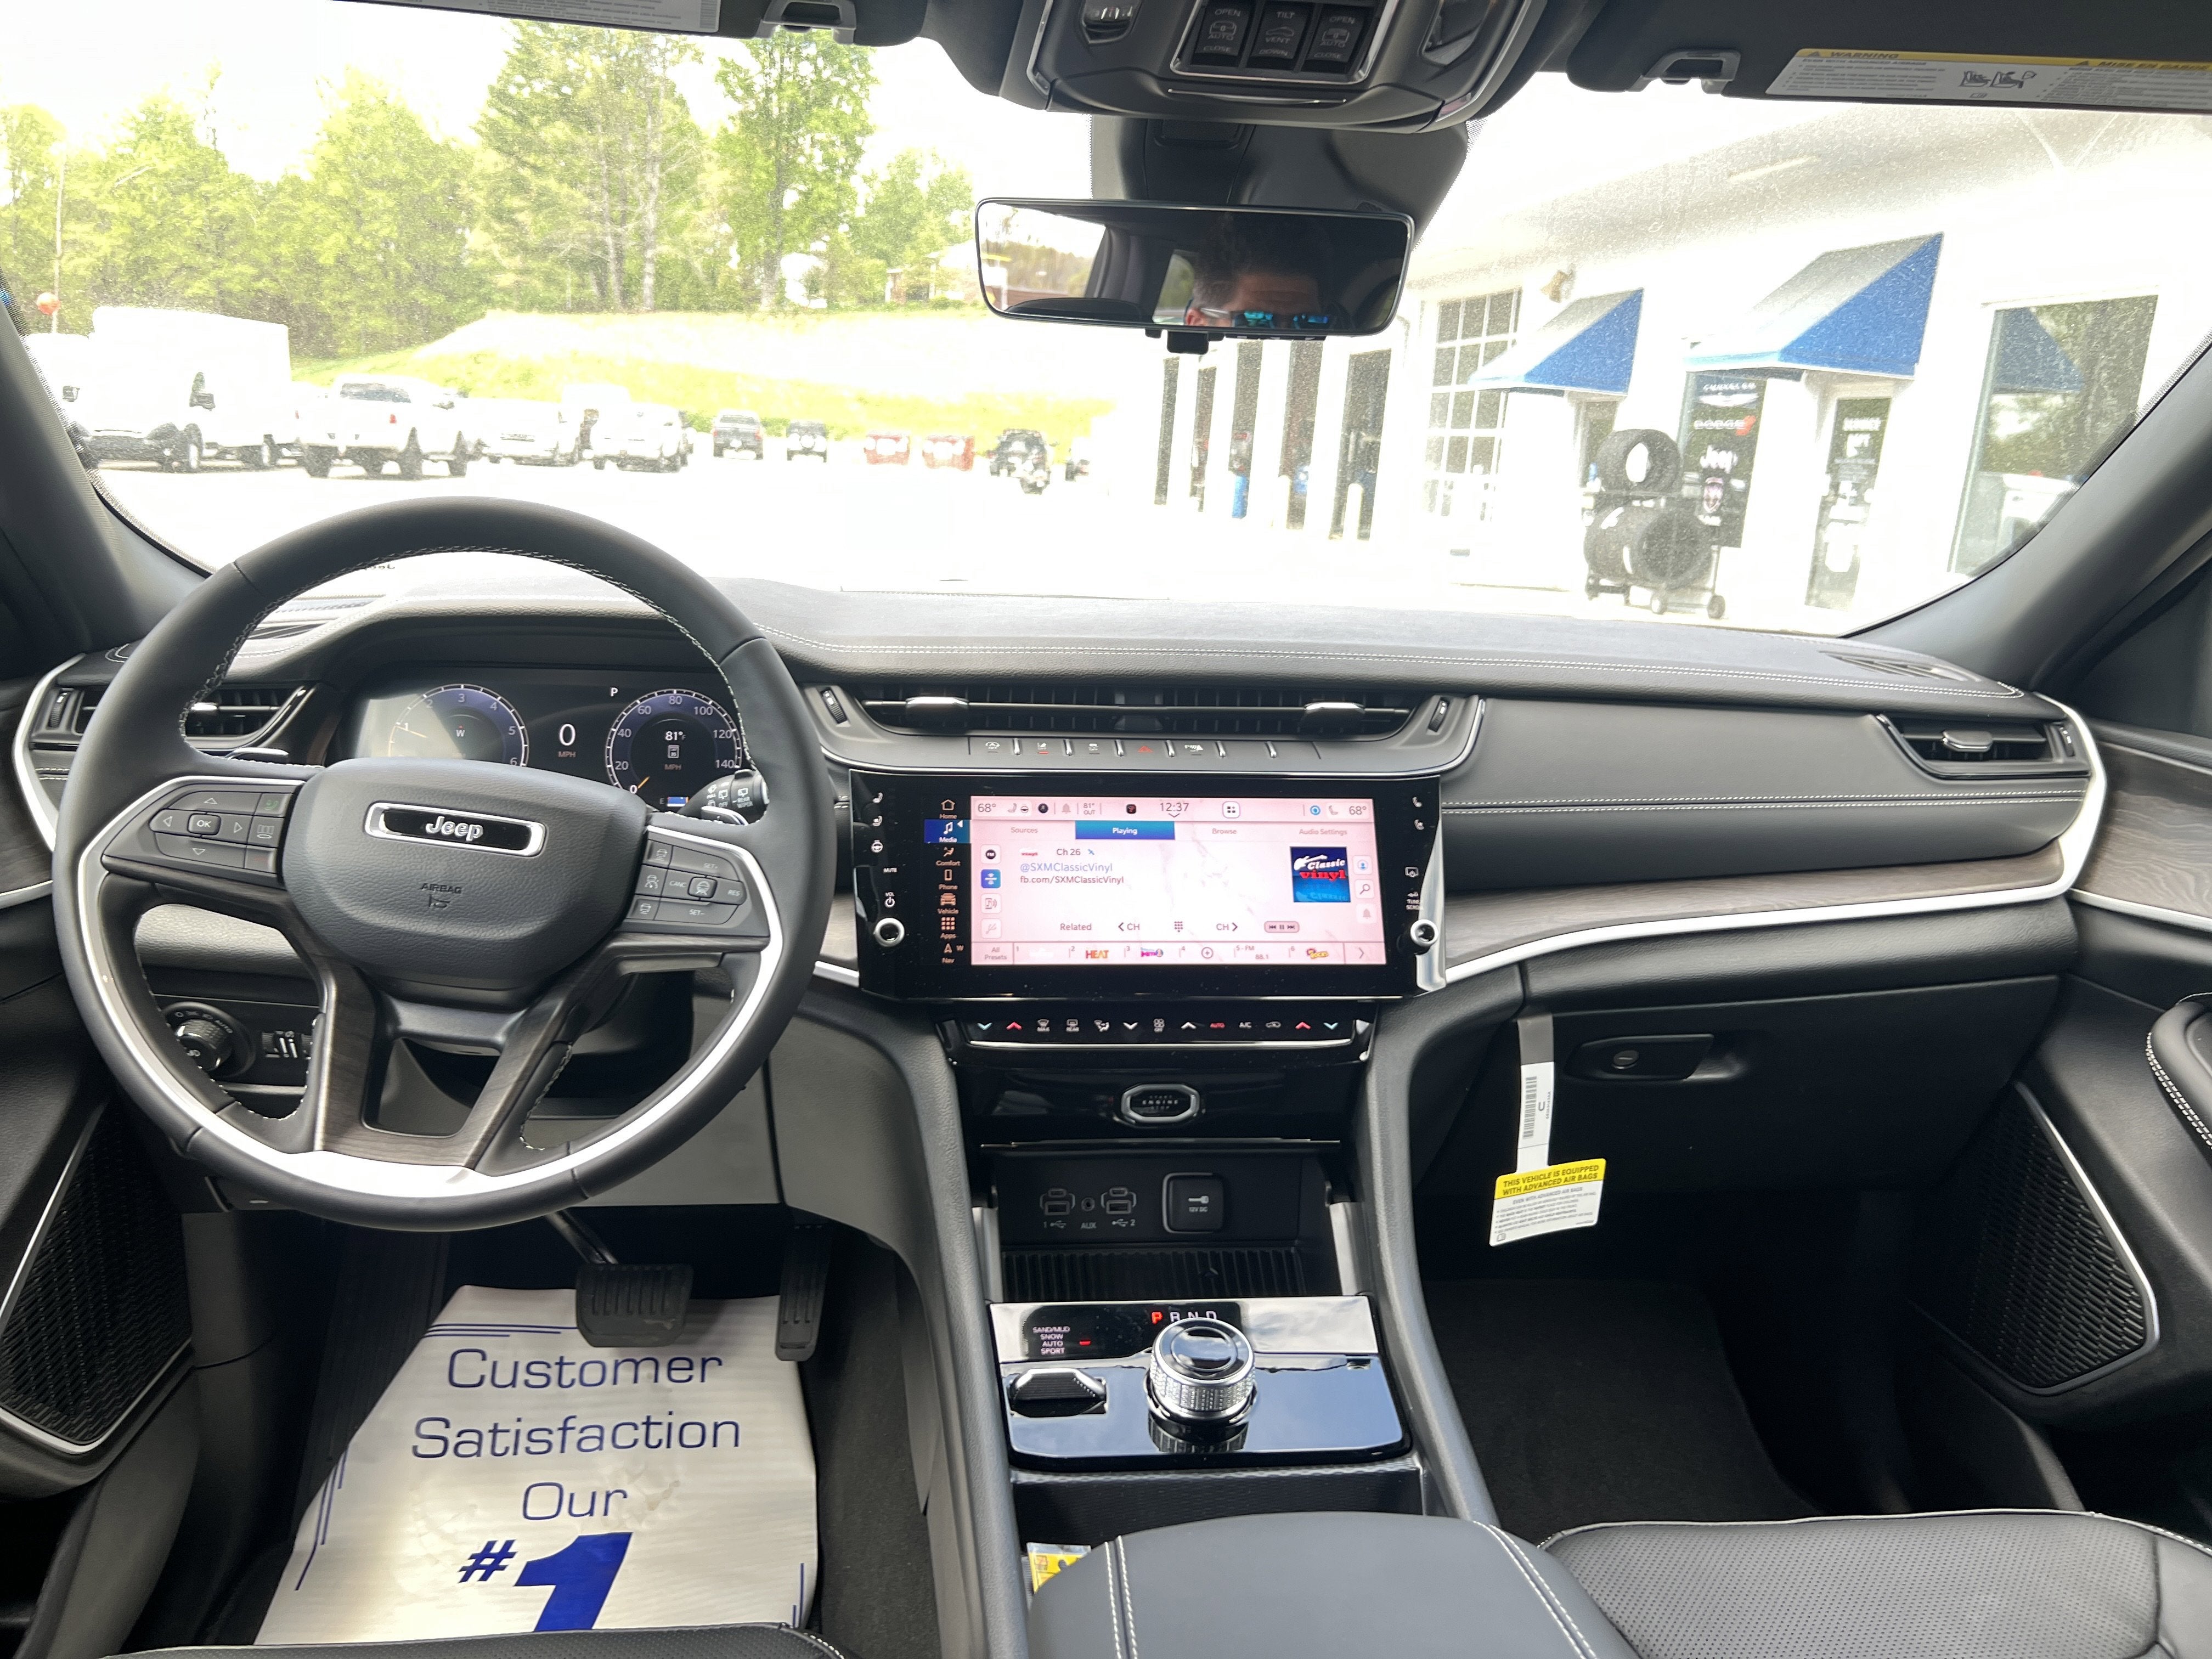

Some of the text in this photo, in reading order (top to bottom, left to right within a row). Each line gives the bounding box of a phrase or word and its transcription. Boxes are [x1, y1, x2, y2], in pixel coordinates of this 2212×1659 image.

[1329, 16, 1356, 24] OPEN
[610, 687, 618, 697] P
[458, 693, 465, 703] 3
[668, 696, 682, 705] 80
[426, 699, 433, 708] 2
[490, 702, 498, 710] 4
[637, 706, 652, 715] 60
[693, 706, 713, 715] 100
[456, 729, 465, 737] W
[508, 726, 516, 735] 5
[559, 724, 576, 746] 0
[617, 729, 631, 738] 40
[713, 729, 732, 739] 120
[510, 757, 517, 766] 6
[615, 761, 629, 770] 20
[715, 759, 735, 769] 140
[630, 785, 637, 794] 0
[978, 803, 996, 812] 68°
[1160, 803, 1189, 812] 12:37
[1349, 806, 1367, 815] 68°
[425, 816, 483, 842] Jeep
[1020, 862, 1113, 873] @SXMClassicVinyl
[1307, 858, 1345, 871] Classic
[1020, 876, 1124, 885] fb.com/SXMClassicVinyl
[1299, 870, 1346, 882] vinyl
[420, 883, 462, 894] AIRBAG
[1085, 950, 1109, 959] HEAT
[1503, 1179, 1520, 1188] THIS
[1522, 1172, 1552, 1184] VEHICLE
[1561, 1165, 1599, 1176] EQUIPPED
[1503, 1187, 1522, 1196] WITH
[1523, 1180, 1562, 1193] ADVANCED
[1578, 1172, 1598, 1181] BAGS
[1152, 1311, 1163, 1324] P
[1170, 1312, 1180, 1323] R
[447, 1347, 724, 1391] Customer
[411, 1411, 741, 1460] Satisfaction
[522, 1482, 628, 1521] Our
[458, 1532, 633, 1633] #1
